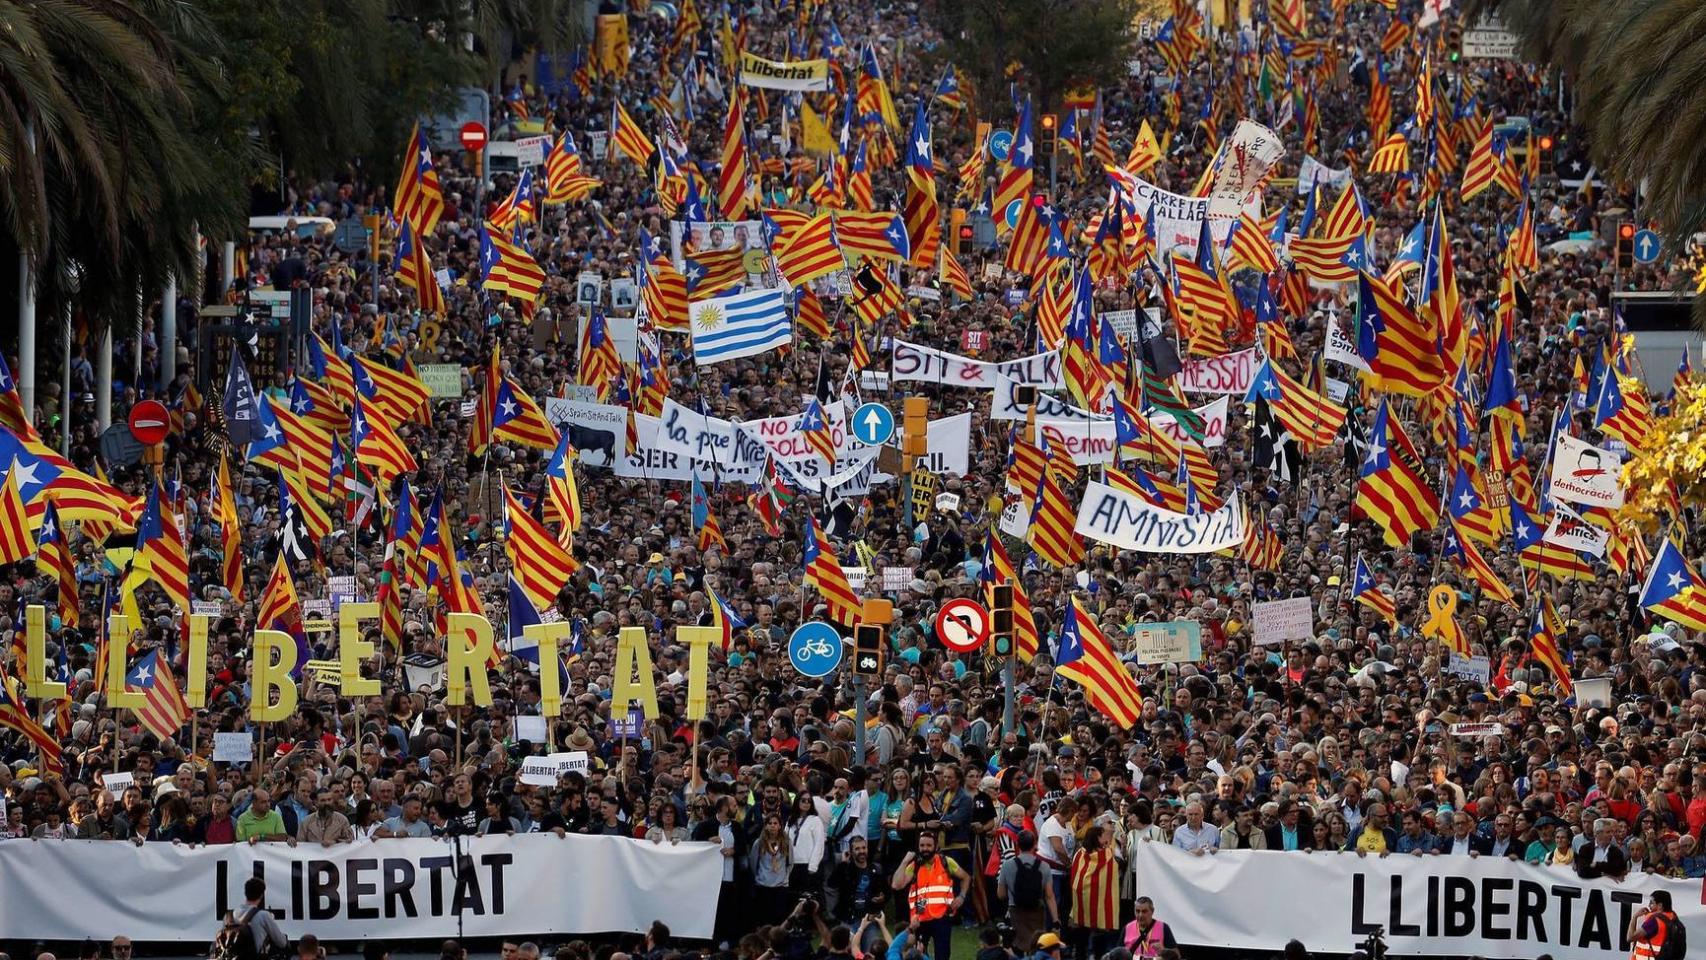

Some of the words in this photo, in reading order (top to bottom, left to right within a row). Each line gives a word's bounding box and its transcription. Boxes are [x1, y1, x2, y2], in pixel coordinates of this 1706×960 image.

[743, 57, 814, 80] Llibertat
[1152, 202, 1206, 222] ALLAD
[967, 331, 982, 343] SIT
[894, 344, 949, 378] SIT
[760, 420, 788, 436] NO
[629, 448, 678, 470] SER
[911, 487, 932, 502] ER
[1351, 873, 1643, 952] LLIBERTAT
